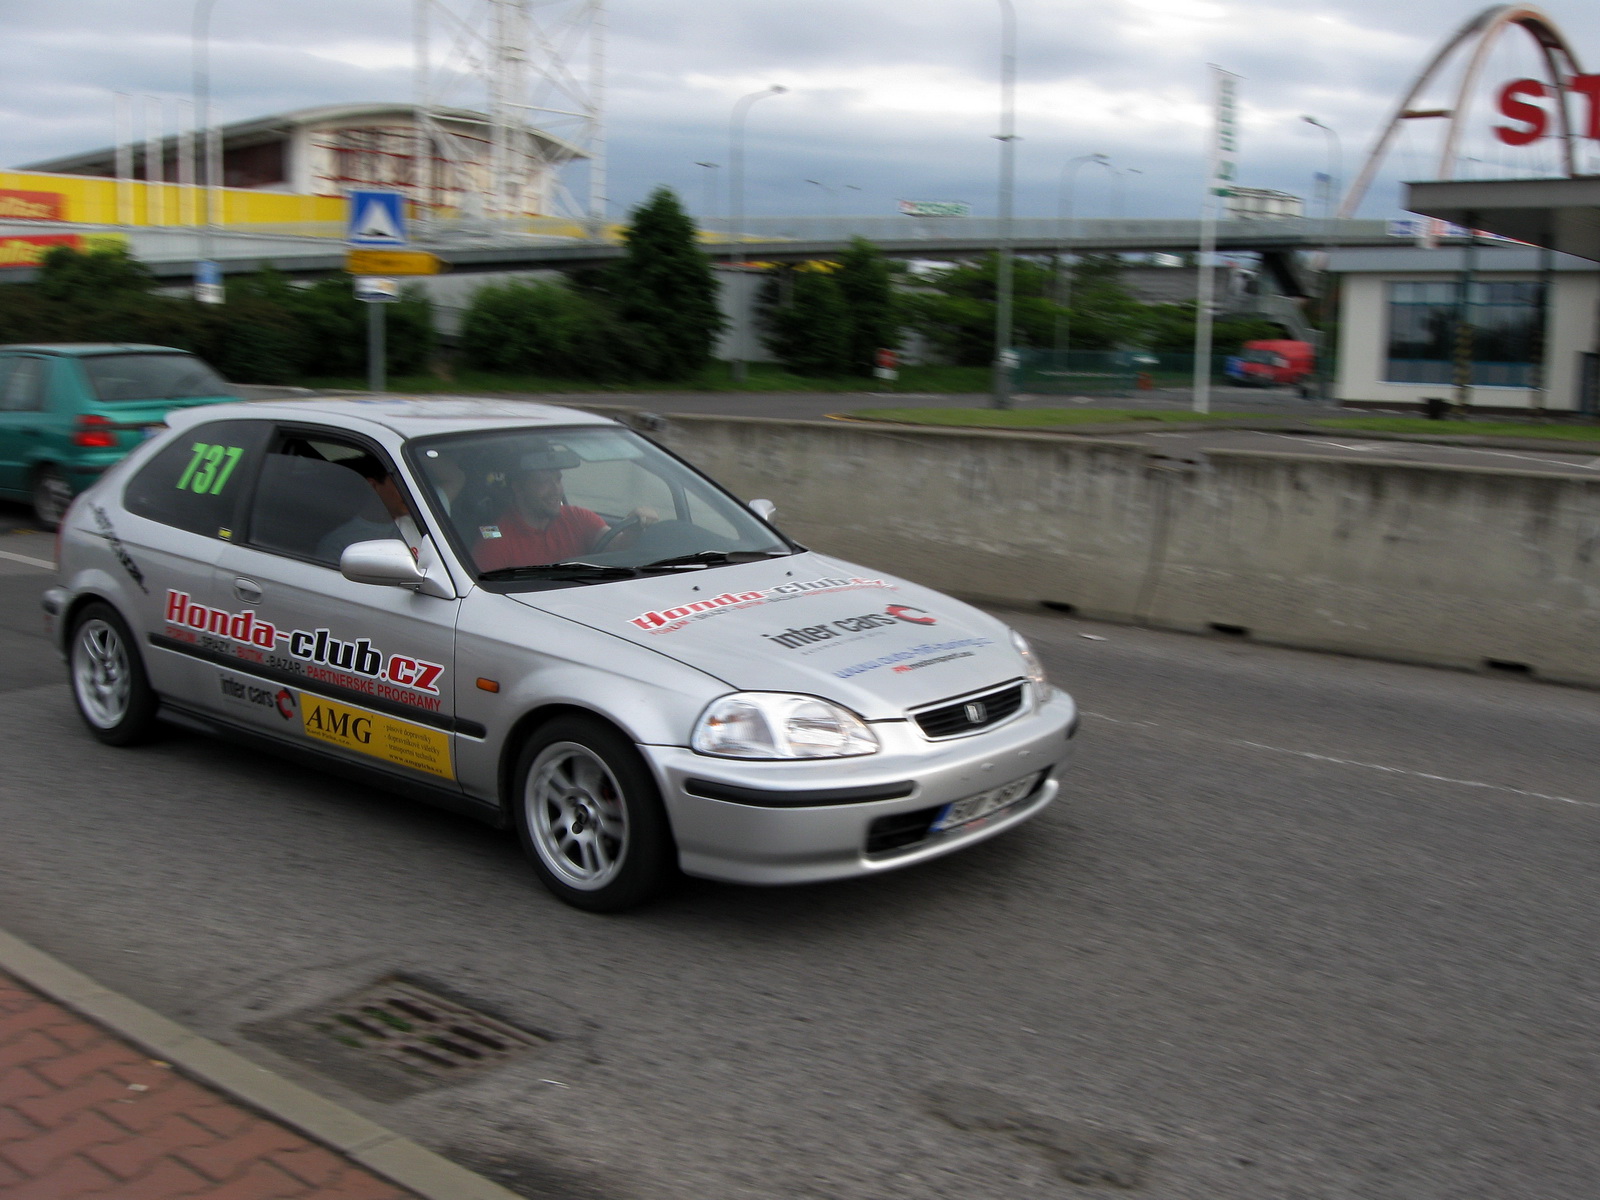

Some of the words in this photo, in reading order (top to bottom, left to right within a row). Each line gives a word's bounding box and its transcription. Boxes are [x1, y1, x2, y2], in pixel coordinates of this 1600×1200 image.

[176, 442, 244, 495] 737
[166, 589, 444, 695] Honda-club.cz
[762, 624, 841, 649] inter
[833, 612, 897, 632] cars
[307, 665, 375, 695] PARTNERSKÉ
[377, 684, 441, 712] PROGRAMY
[306, 705, 373, 744] AMG
